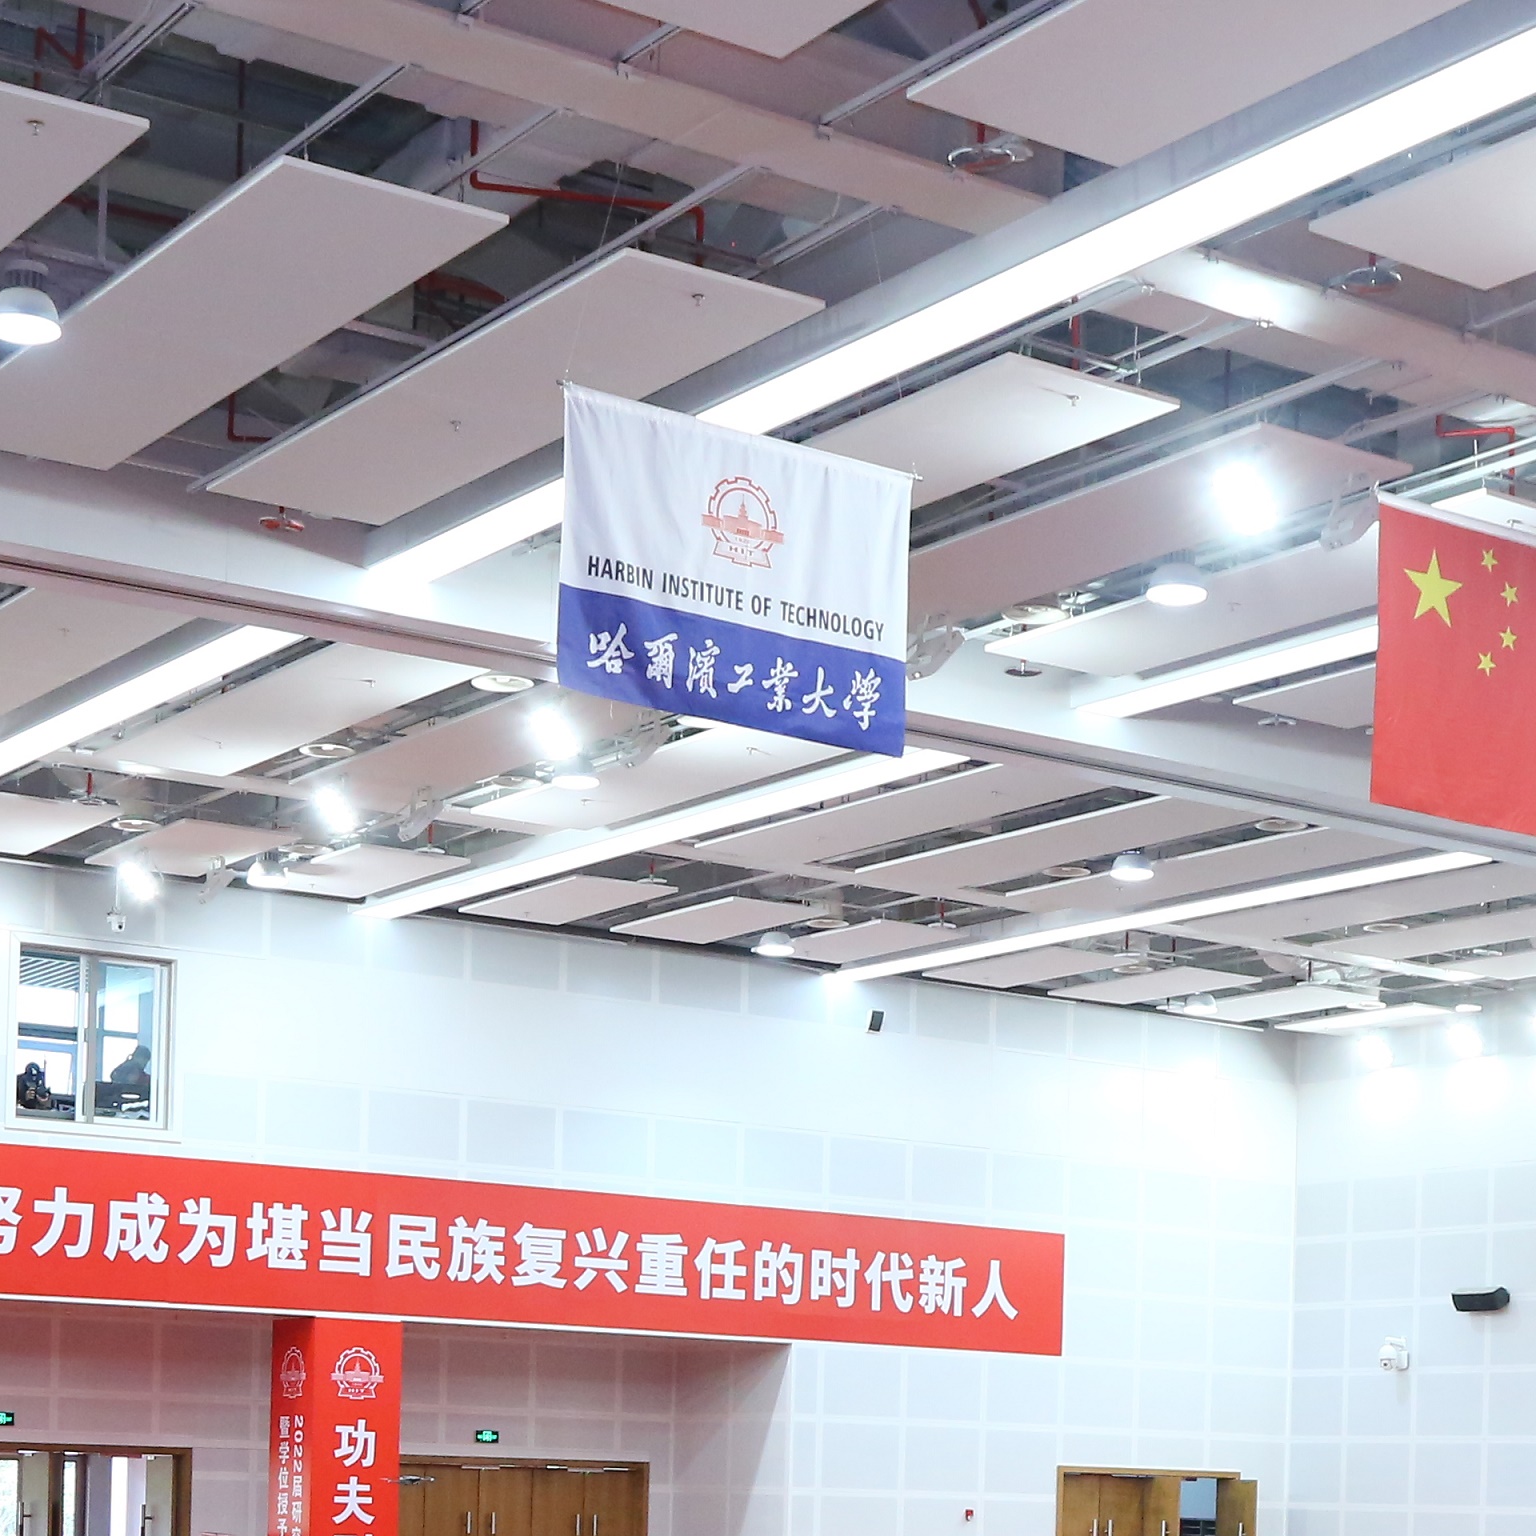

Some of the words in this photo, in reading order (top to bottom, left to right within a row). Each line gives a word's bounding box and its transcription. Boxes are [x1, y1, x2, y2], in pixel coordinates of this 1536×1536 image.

[729, 545, 754, 556] HIT
[586, 555, 654, 590] HARBIN
[662, 572, 744, 611] INSTITUTE
[750, 595, 772, 616] OF
[780, 600, 885, 642] TECHNOLOGY
